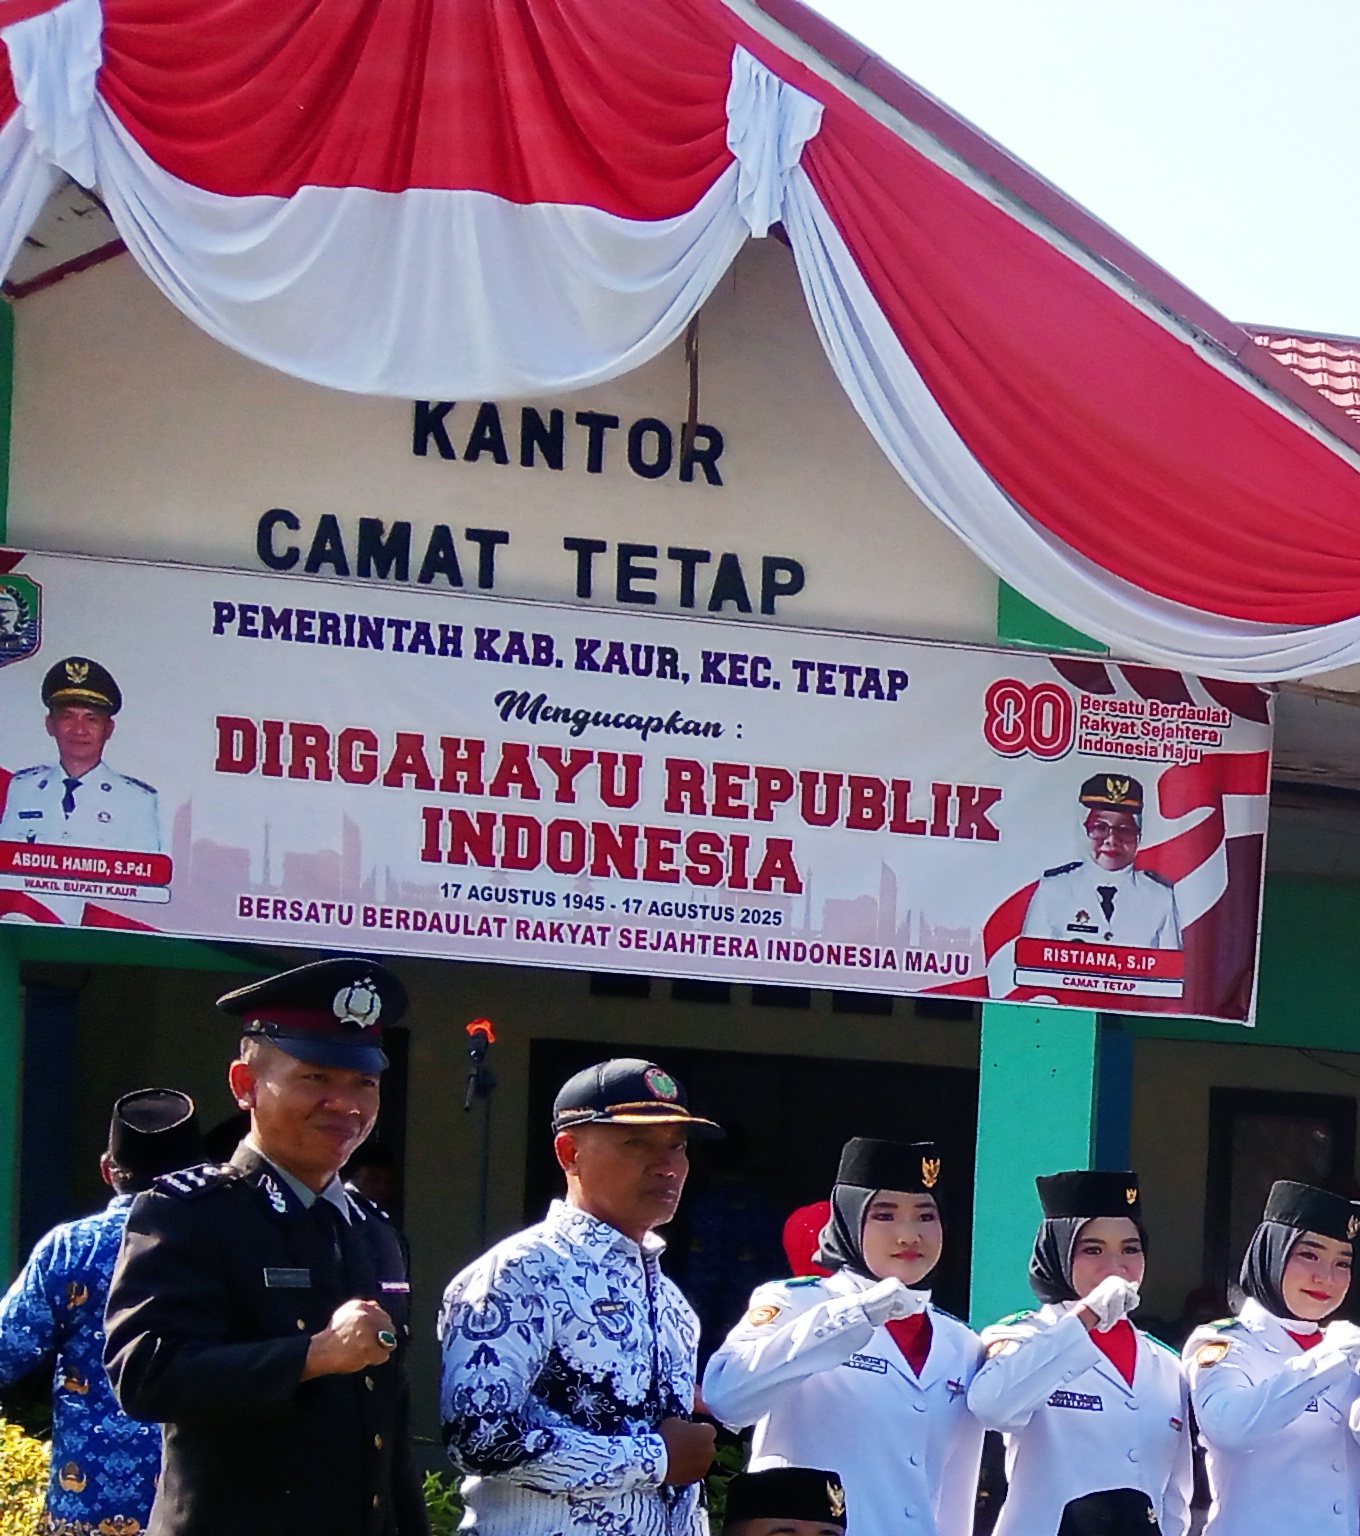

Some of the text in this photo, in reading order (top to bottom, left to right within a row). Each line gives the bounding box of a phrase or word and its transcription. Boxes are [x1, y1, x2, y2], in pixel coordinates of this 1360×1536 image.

[411, 400, 725, 487] KANTOR
[256, 508, 806, 615] CAMAT TETAP
[212, 600, 909, 702] PEMERINTAH KAB. KAUR, KEC. TETAP
[493, 689, 726, 742] Mengucapkan
[984, 678, 1074, 757] 80
[1079, 714, 1219, 743] Rakyat Sejahtera
[1080, 694, 1229, 724] Bersatu Berdaulat
[1078, 734, 1199, 763] Indonesia Maju
[214, 715, 1004, 842] DIRGAHAYU REPUBLIK
[12, 851, 59, 870] ABDUL
[62, 856, 111, 877] HAMID,
[420, 806, 804, 895] INDONESIA
[24, 877, 137, 898] WAKIL BUPATI KAUR
[440, 882, 462, 900] 17
[467, 885, 557, 907] AGUSTUS
[562, 892, 605, 911] 1945
[621, 897, 643, 915] 17
[648, 901, 735, 922] AGUSTUS
[740, 907, 782, 926] 2025
[238, 895, 970, 976] BERSATU BERDAULAT RAKYAT SEJAHTERA INDONESIA MAJU
[1043, 947, 1157, 971] RISTIANA, S.IP
[1062, 976, 1136, 992] CAMAT TETAP
